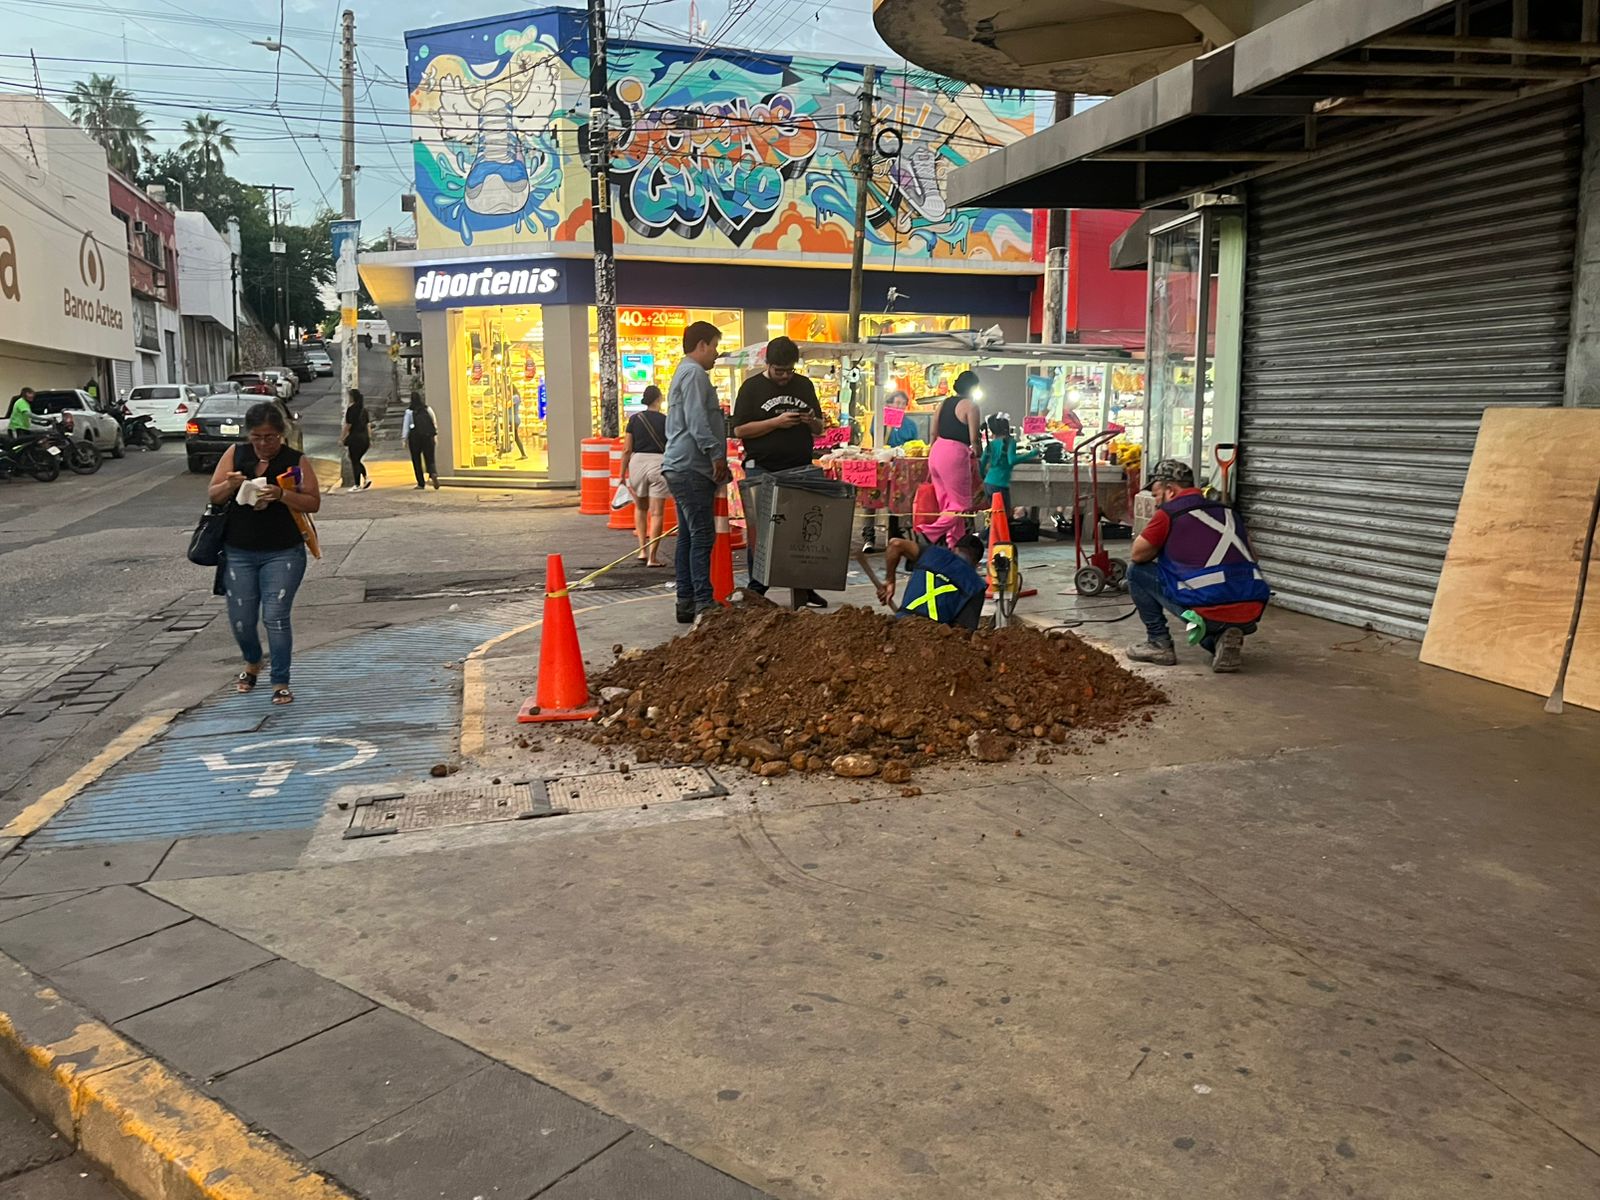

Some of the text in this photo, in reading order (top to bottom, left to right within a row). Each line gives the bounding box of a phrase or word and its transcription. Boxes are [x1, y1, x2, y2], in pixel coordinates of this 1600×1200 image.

[836, 102, 933, 144] LKE!
[414, 267, 559, 302] dportenis
[63, 287, 94, 322] Banco
[95, 298, 123, 330] Azteca
